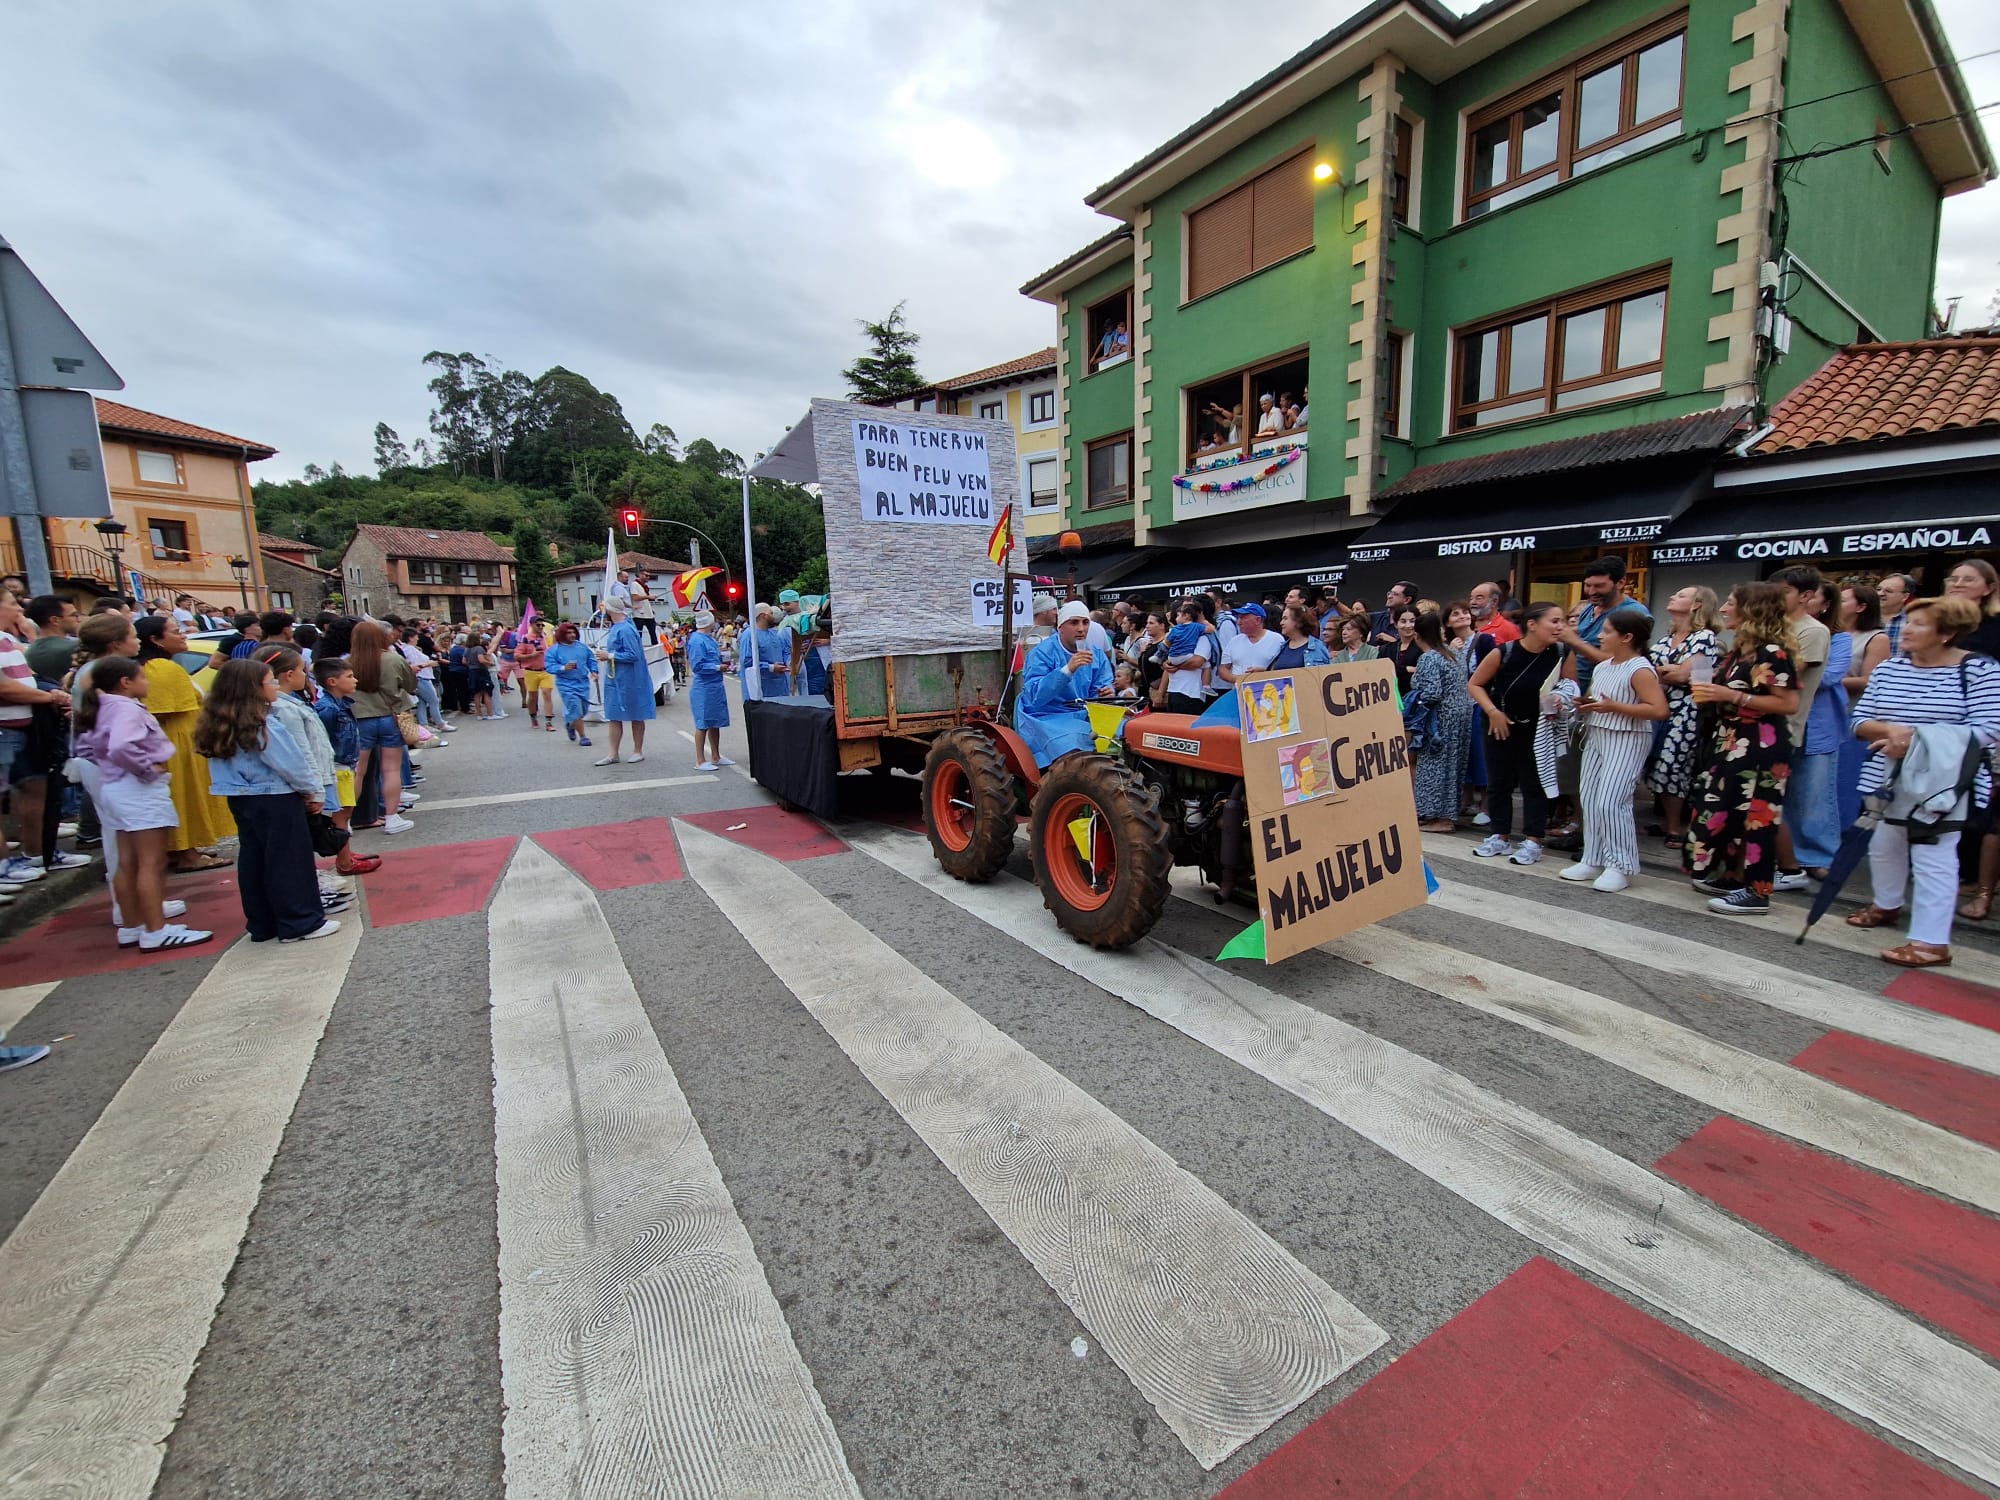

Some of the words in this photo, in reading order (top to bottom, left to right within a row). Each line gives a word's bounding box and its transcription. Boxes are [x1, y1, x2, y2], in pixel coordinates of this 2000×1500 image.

[858, 423, 899, 444] PARA
[865, 448, 908, 472] BUEN
[913, 464, 950, 485] PELU
[957, 473, 987, 490] VEN
[876, 491, 903, 516] AL
[909, 492, 989, 519] MAJUELU
[1600, 524, 1662, 539] KELER
[1438, 539, 1492, 556] BISTRO
[1500, 536, 1535, 551] BAR
[1652, 545, 1719, 560] KELER
[1737, 538, 1828, 559] COCINA
[1842, 527, 1991, 553] ESPAÑOLA
[1350, 548, 1390, 559] KELER
[1307, 572, 1343, 583] KELER
[973, 582, 1021, 597] CREE
[1169, 588, 1181, 598] LA
[984, 599, 1024, 617] PEU
[1261, 814, 1302, 863] EL
[1268, 823, 1403, 931] MAJUELU
